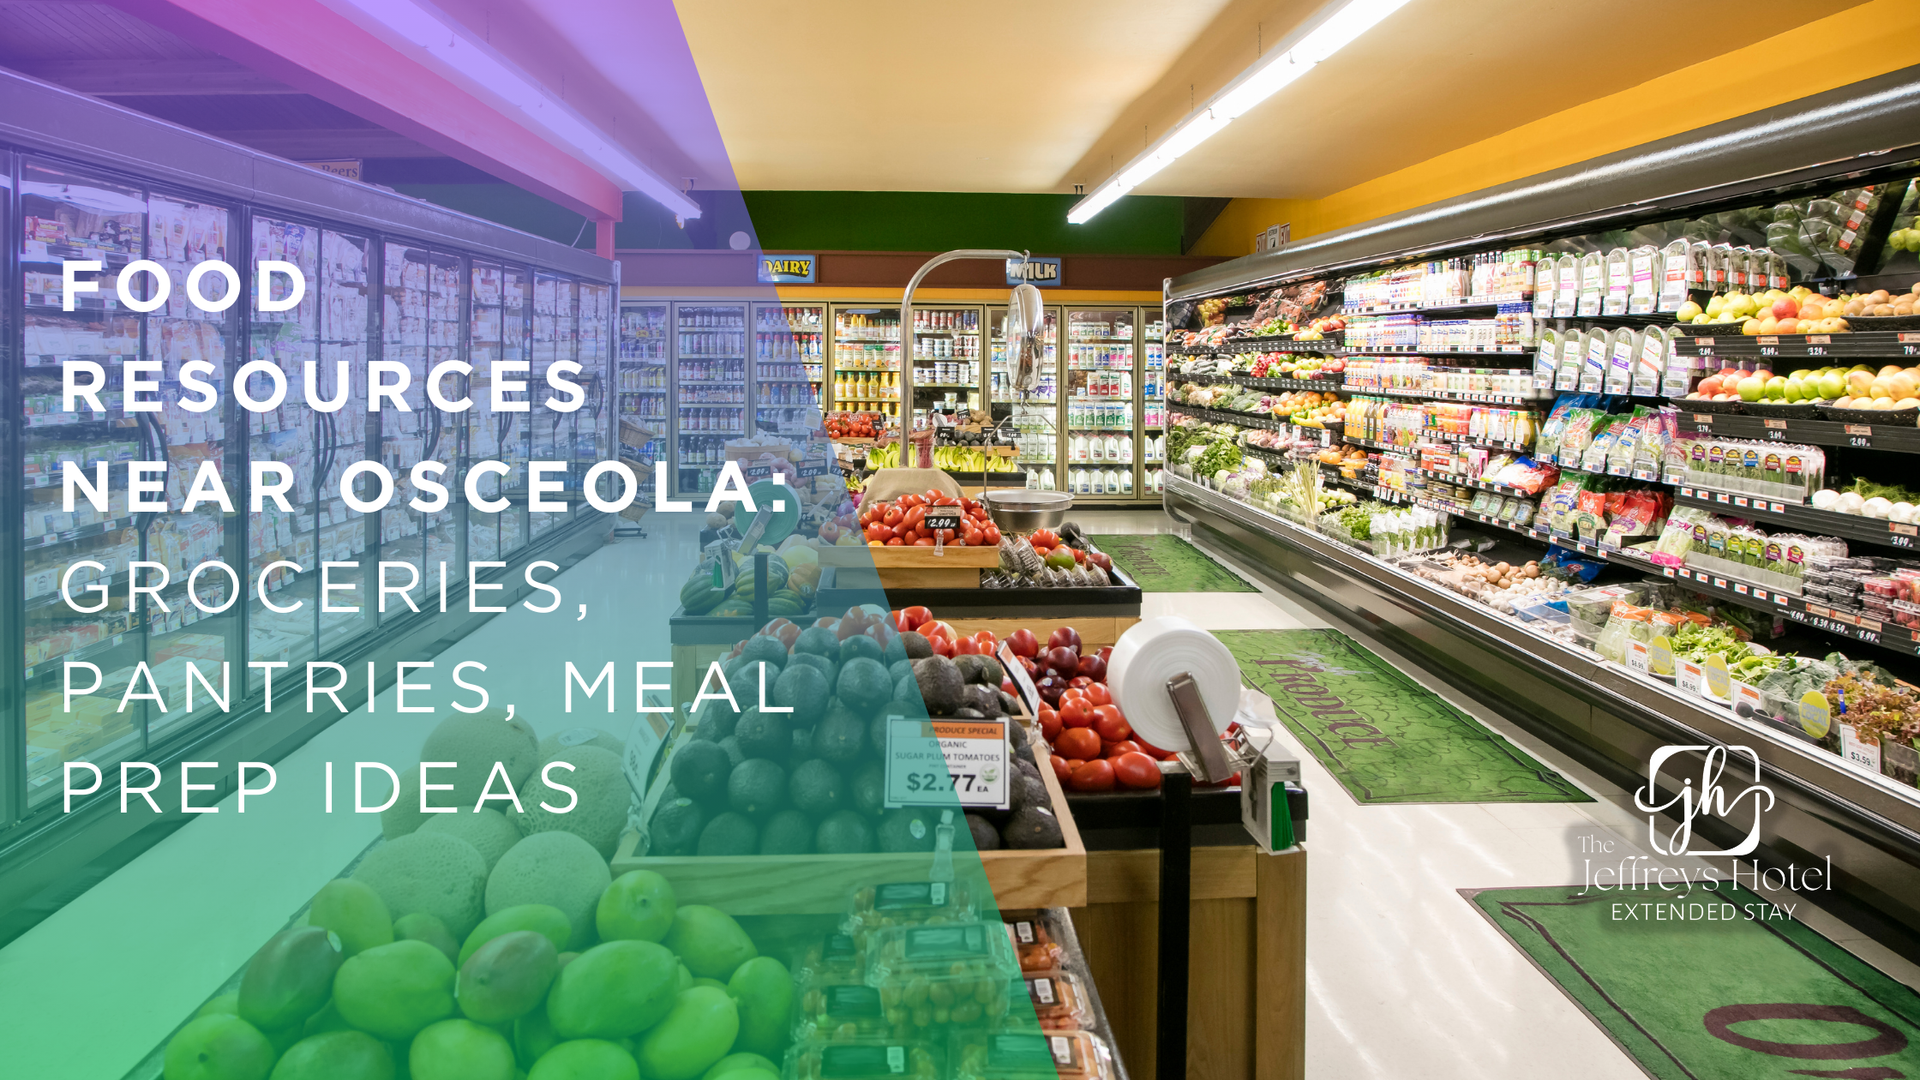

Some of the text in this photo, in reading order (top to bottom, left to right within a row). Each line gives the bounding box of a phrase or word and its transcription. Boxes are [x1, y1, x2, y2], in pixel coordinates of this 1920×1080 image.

[761, 260, 811, 277] DAIRY
[1010, 262, 1058, 280] MILK
[1254, 659, 1400, 750] PRODUCE
[1801, 708, 1828, 727] LOCAL
[929, 726, 998, 735] PRODUCE SPECIAL
[928, 741, 967, 749] ORGANIC
[895, 752, 1000, 762] SUGAR PLUM TOMATOES
[906, 772, 977, 793] $2.77
